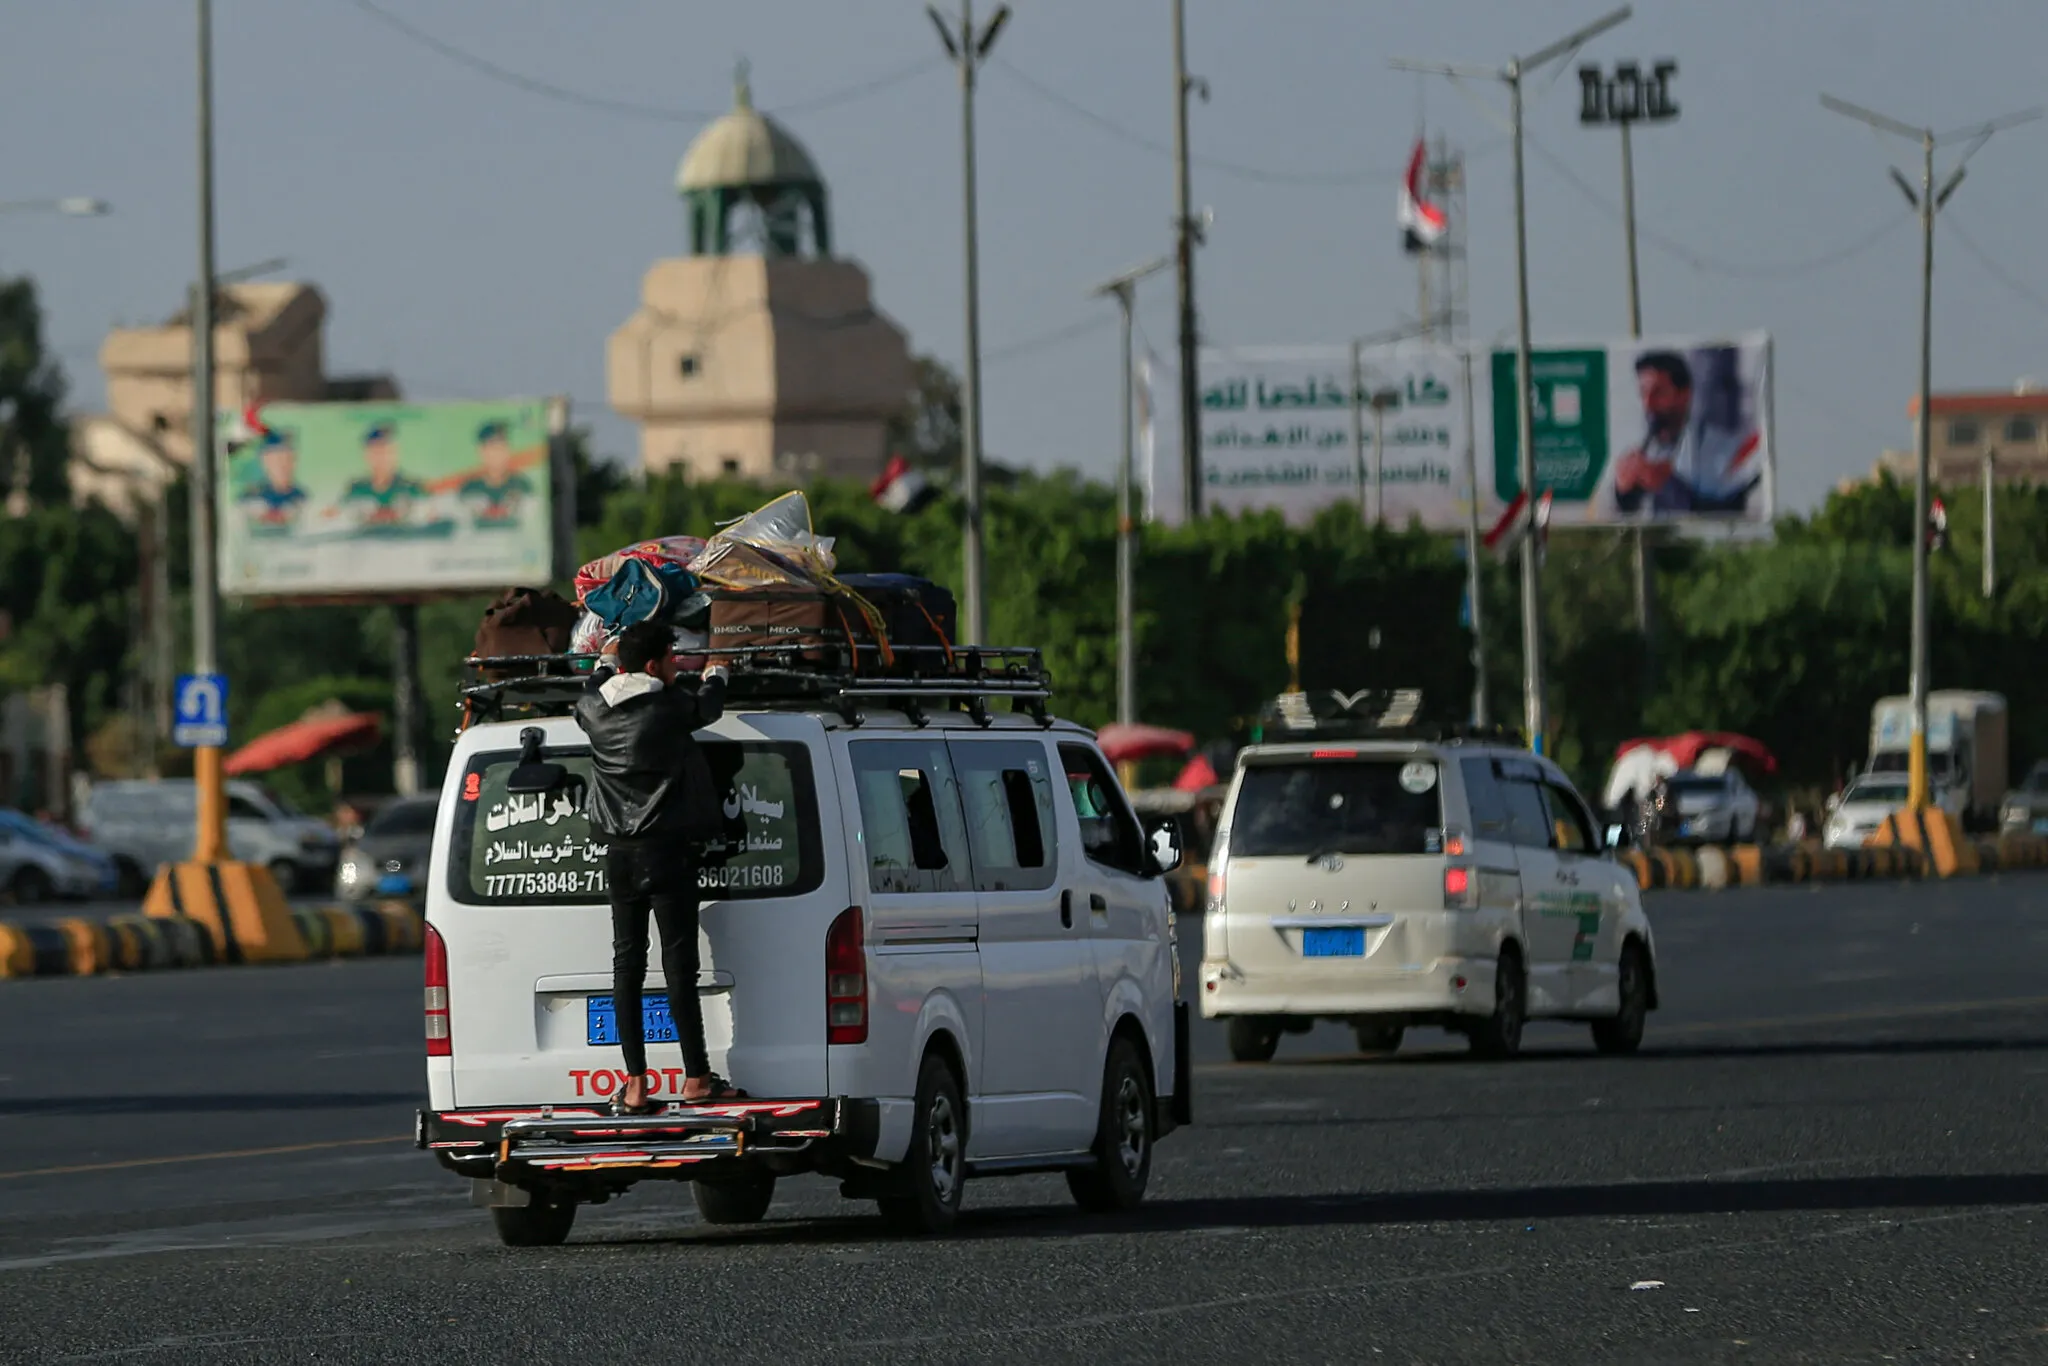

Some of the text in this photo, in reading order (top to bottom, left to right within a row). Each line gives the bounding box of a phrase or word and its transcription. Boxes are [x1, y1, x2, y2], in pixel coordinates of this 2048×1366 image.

[723, 783, 784, 824] سيلان
[485, 870, 609, 897] 777753848-71
[644, 1027, 673, 1040] 919
[568, 1068, 686, 1096] TOYOT
